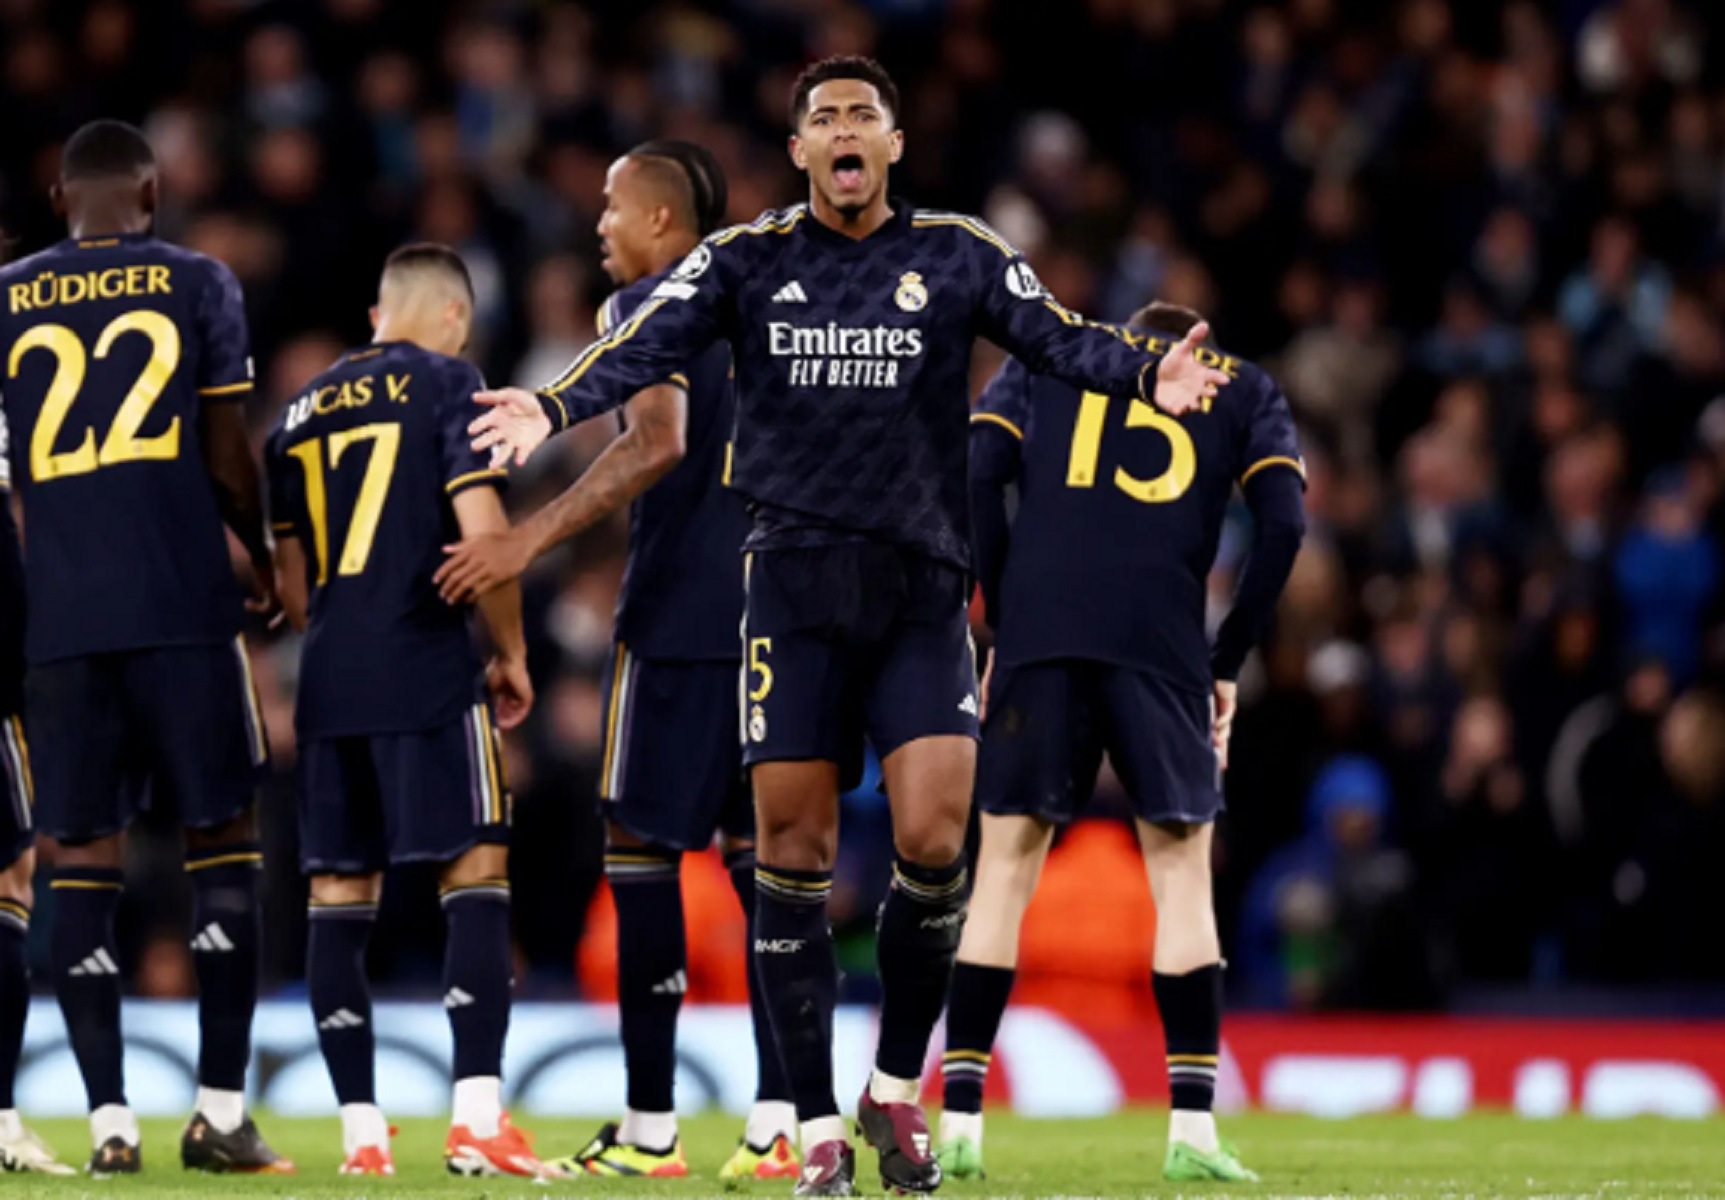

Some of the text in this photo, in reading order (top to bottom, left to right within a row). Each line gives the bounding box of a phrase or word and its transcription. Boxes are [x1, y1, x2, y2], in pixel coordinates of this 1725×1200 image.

[8, 264, 172, 314] RÜDIGER
[768, 321, 923, 356] Emirates
[7, 309, 181, 483] 22
[285, 373, 412, 431] LUCAS V.
[789, 359, 899, 388] FLY BETTER
[1066, 381, 1216, 504] 15
[287, 422, 402, 586] 17
[749, 637, 774, 701] 5
